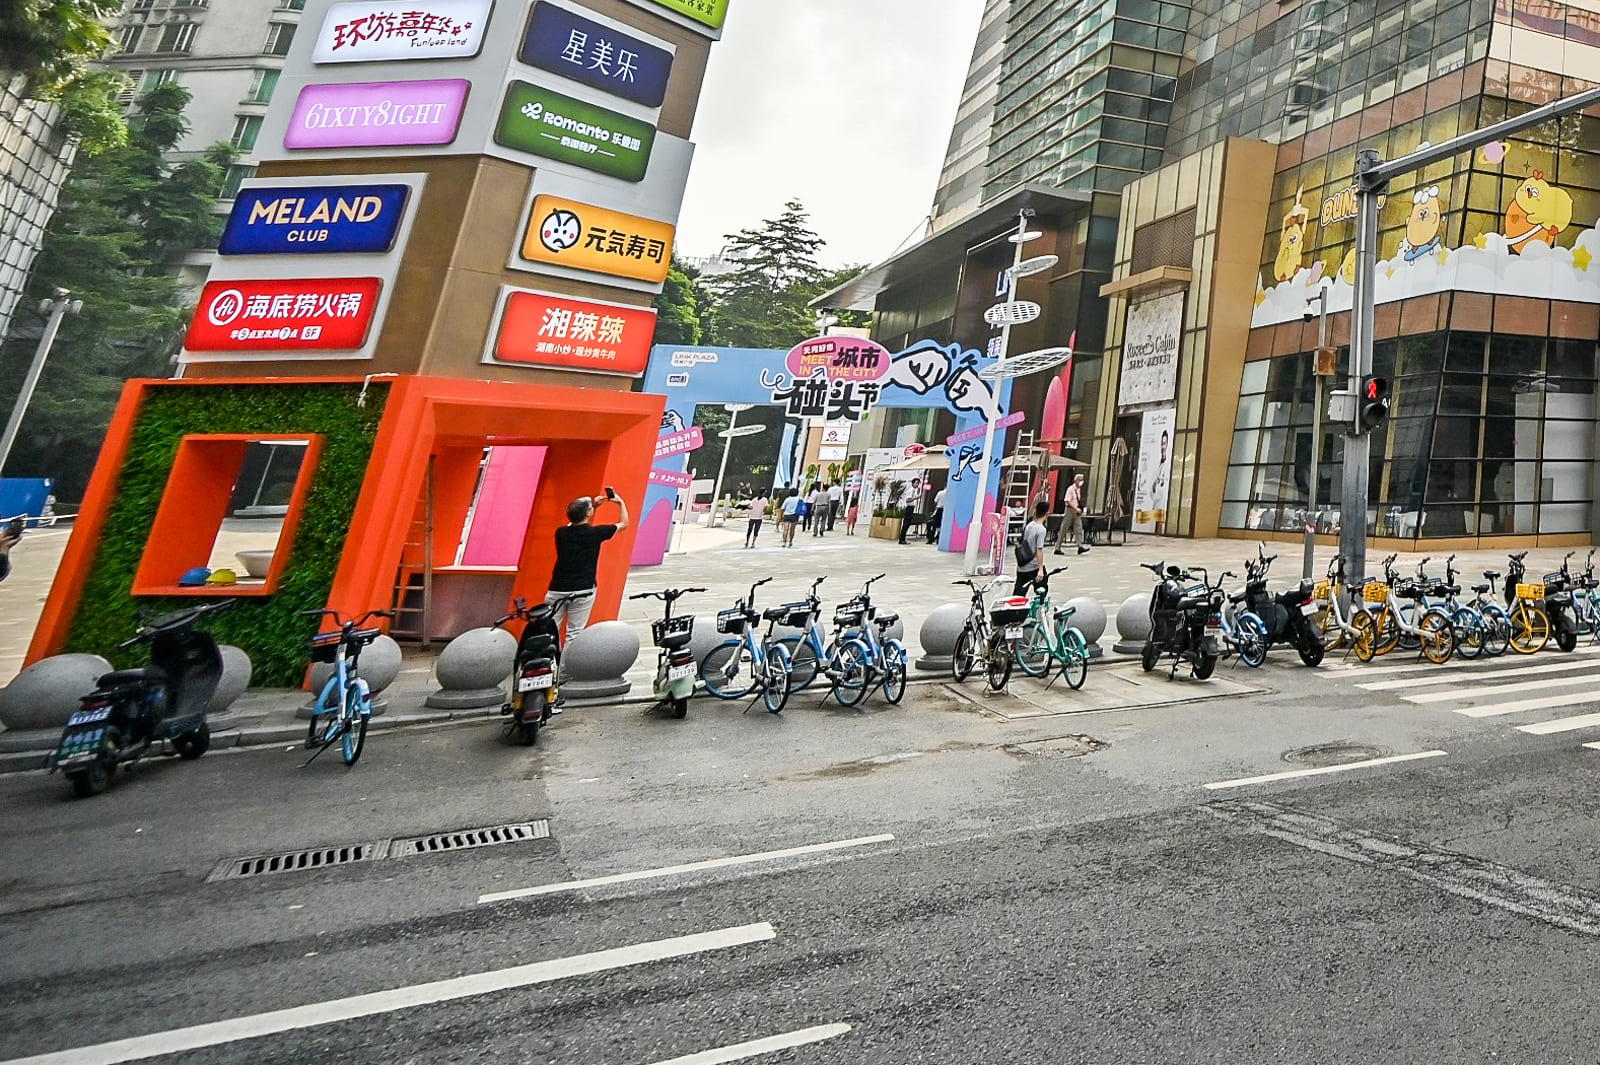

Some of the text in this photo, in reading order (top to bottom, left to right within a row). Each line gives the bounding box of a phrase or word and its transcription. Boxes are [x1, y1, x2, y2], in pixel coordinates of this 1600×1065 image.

[560, 28, 640, 84] 星美乐
[305, 100, 448, 130] 6IXTY8IGHT
[543, 111, 610, 142] Romanto
[248, 195, 384, 227] MELAND
[286, 229, 329, 243] CLUB
[242, 293, 363, 319] 海底捞火锅
[537, 307, 626, 345] 湘辣辣
[798, 366, 811, 375] IN
[800, 355, 833, 365] MEET
[833, 346, 881, 369] 城市
[773, 379, 880, 421] 碰头节
